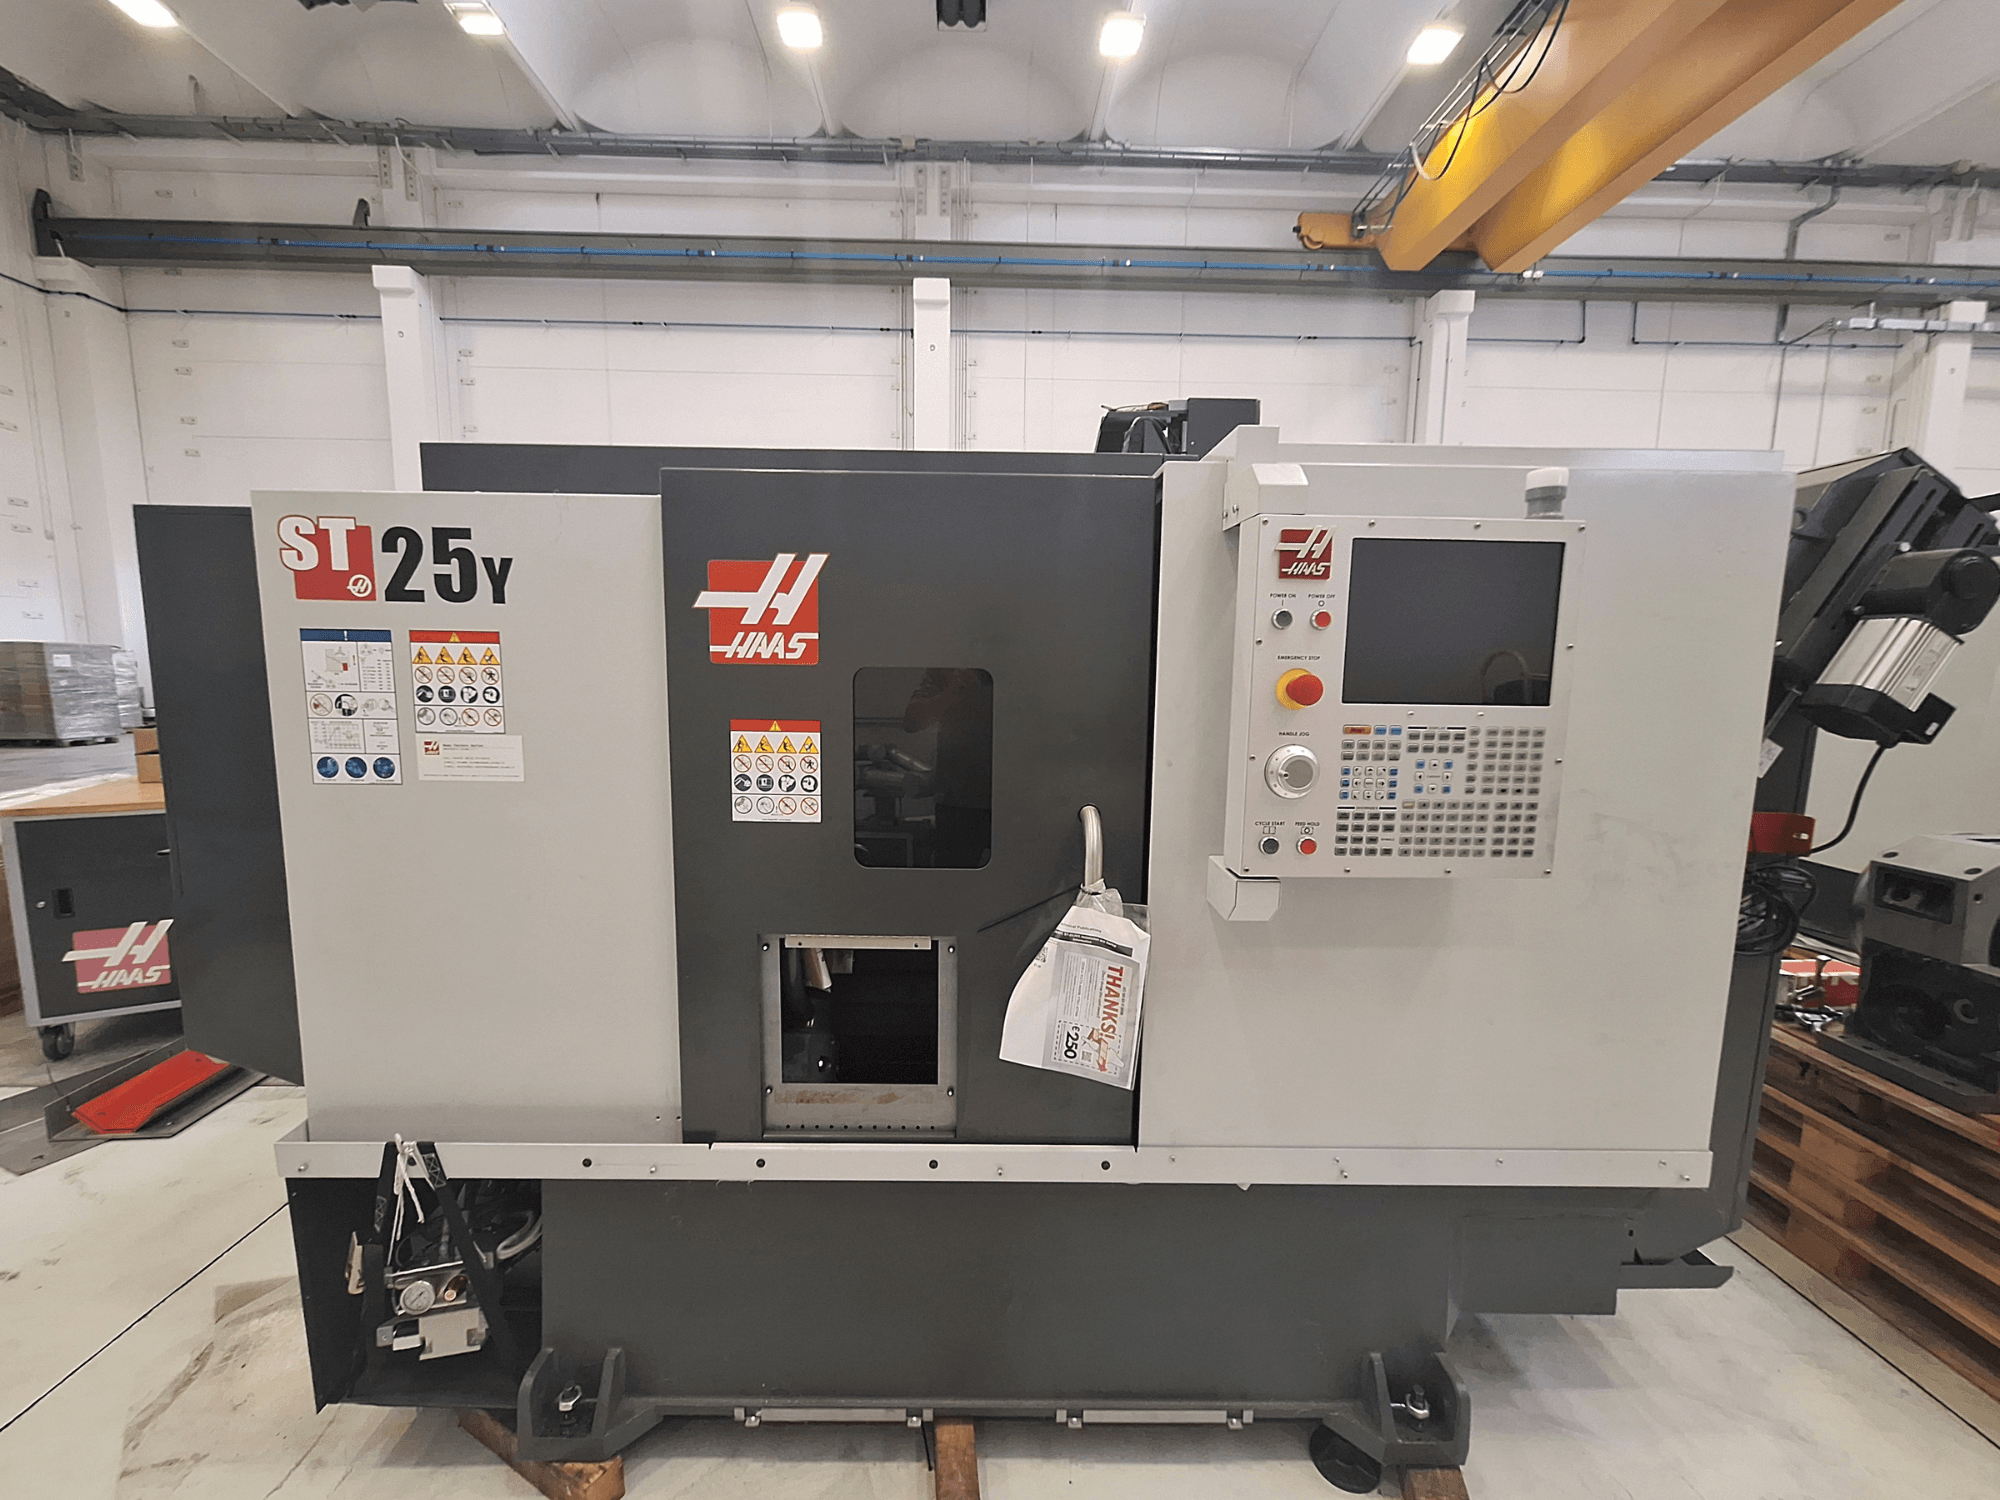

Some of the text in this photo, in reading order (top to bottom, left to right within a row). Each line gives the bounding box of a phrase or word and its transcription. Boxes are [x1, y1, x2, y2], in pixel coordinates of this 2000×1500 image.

[277, 515, 357, 572] ST
[1281, 562, 1331, 576] HAAS
[709, 631, 819, 659] HAAS
[77, 964, 171, 990] HAAS
[1100, 965, 1124, 1040] THANKS!
